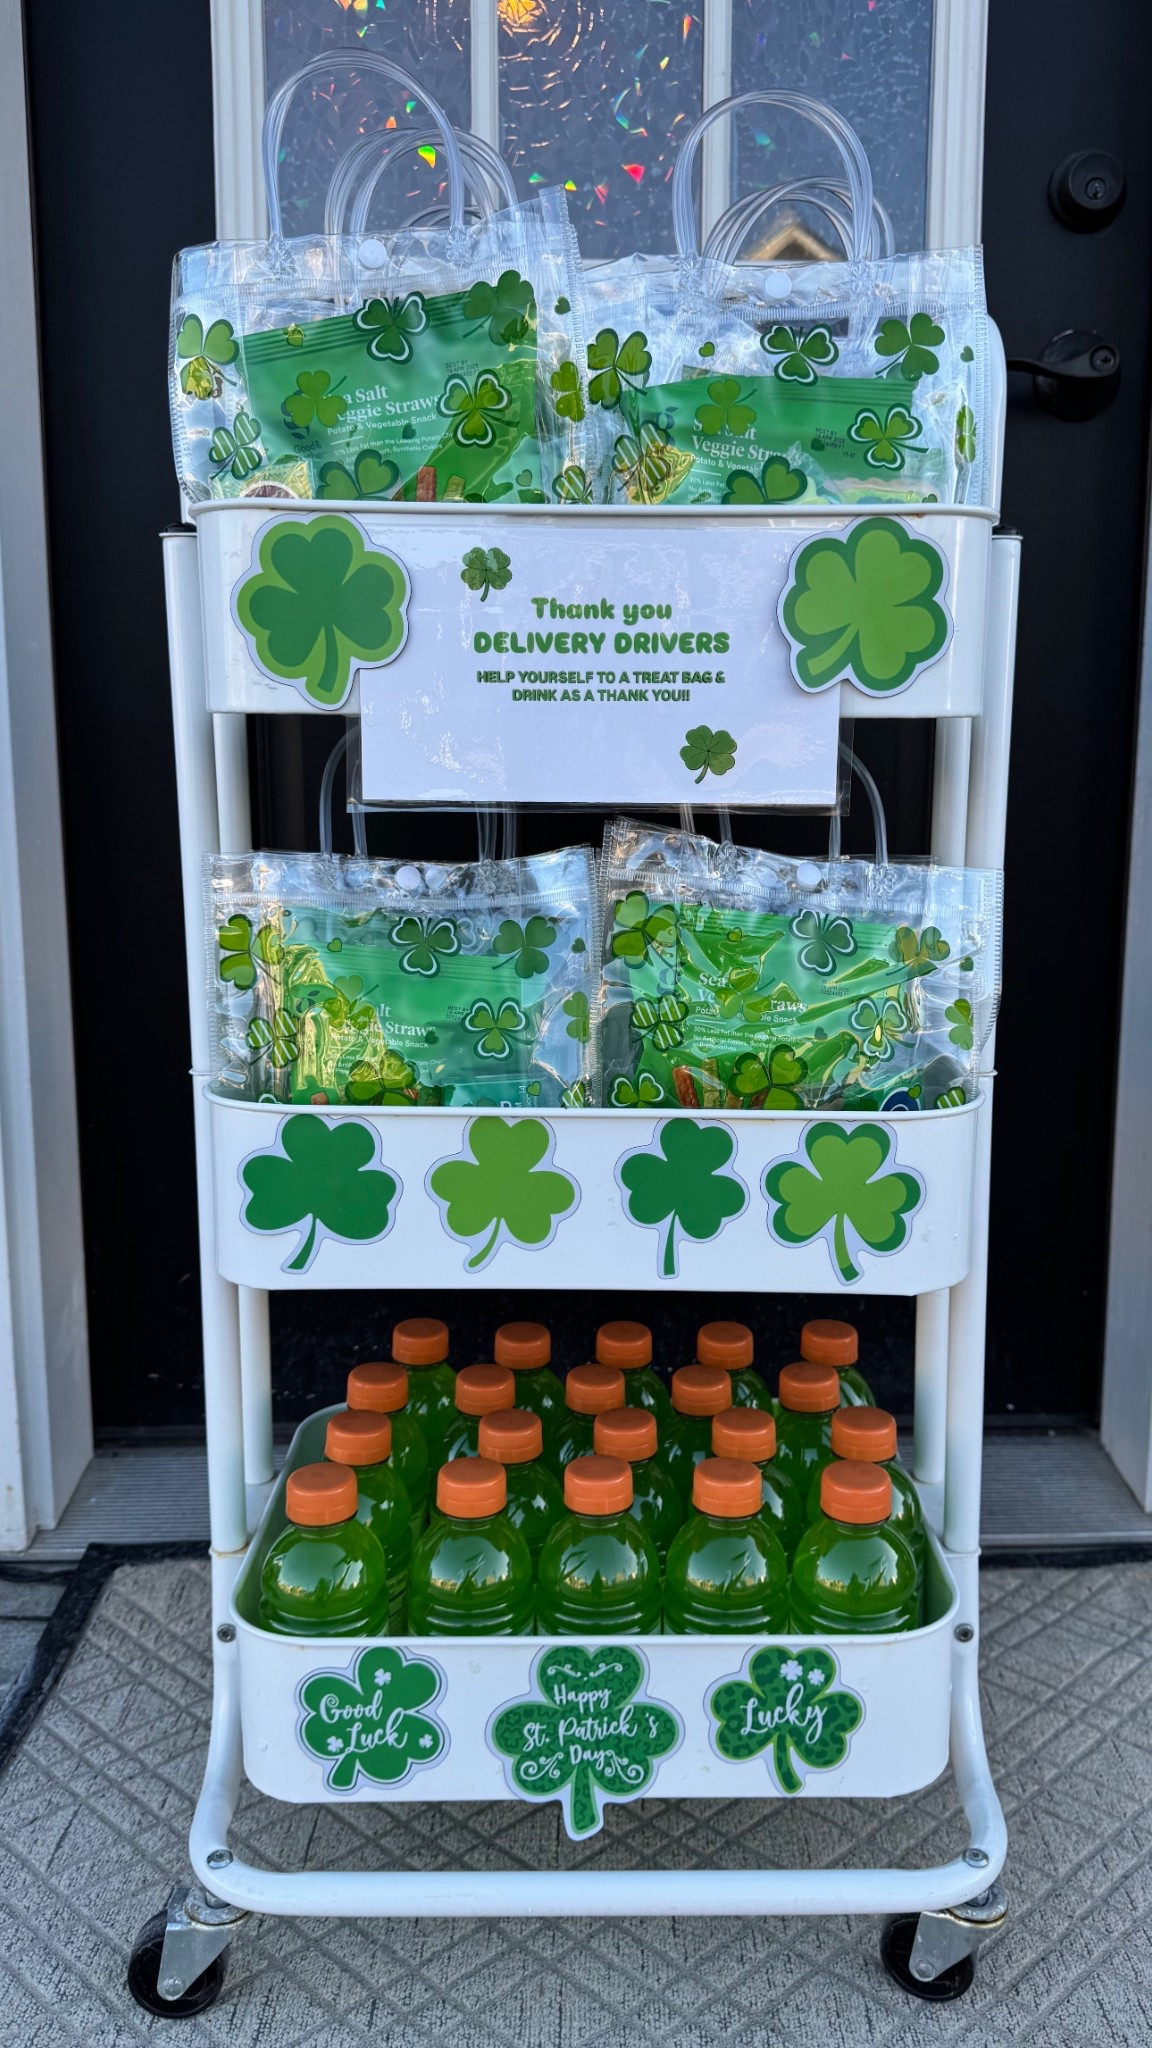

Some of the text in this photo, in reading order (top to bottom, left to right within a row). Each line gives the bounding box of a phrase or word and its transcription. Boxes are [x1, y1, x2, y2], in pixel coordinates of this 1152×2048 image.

[355, 385, 389, 403] Salt
[337, 394, 440, 424] eggie Straws
[327, 413, 437, 436] Potato & Vegetable Snack
[692, 435, 745, 459] Veggie
[690, 454, 716, 467] Potato
[531, 597, 672, 626] Thank you
[473, 631, 730, 654] DELIVERY DRIVERS
[477, 671, 726, 684] HELP YOURSELF TO A TREAT BAG &
[512, 689, 691, 702] DRINK AS A THANK YOU!!
[699, 972, 727, 988] Sea
[770, 1000, 808, 1013] raws
[405, 1040, 429, 1049] Snack
[320, 1689, 383, 1724] Good
[554, 1683, 612, 1714] Happy
[740, 1683, 828, 1744] Lucky
[346, 1707, 408, 1754] Luck
[523, 1722, 550, 1752] St.
[569, 1744, 606, 1771] Day
